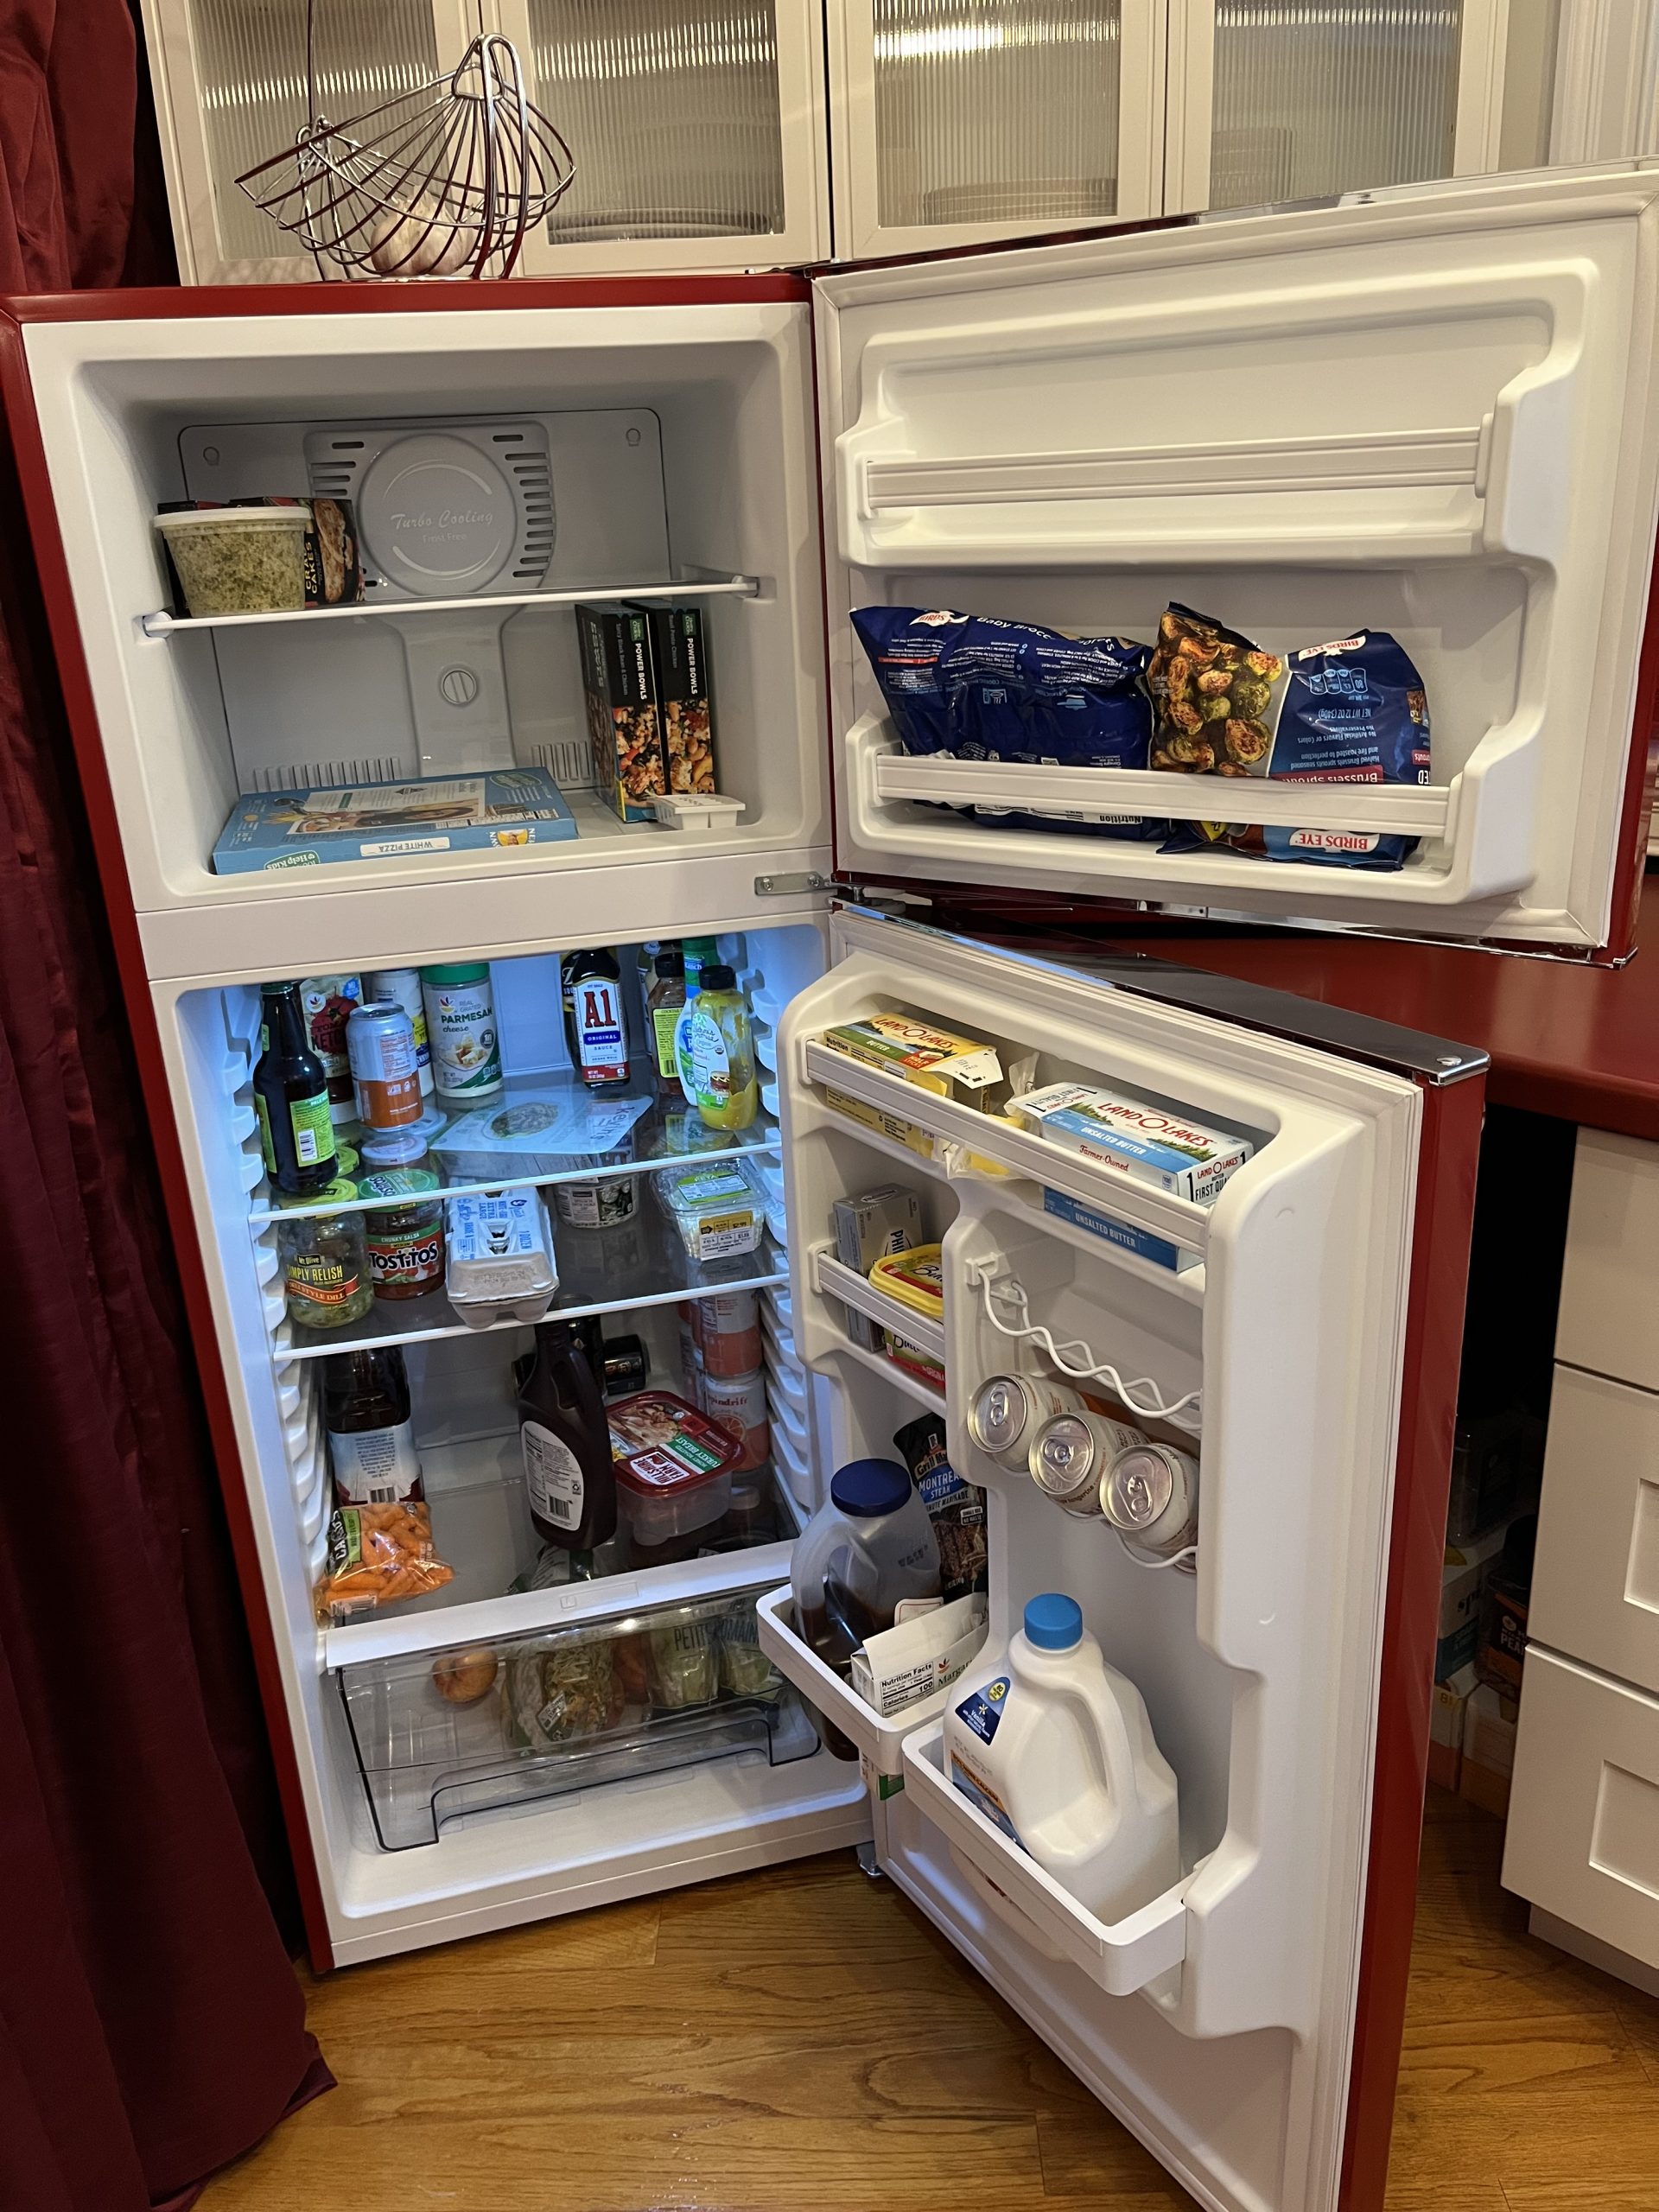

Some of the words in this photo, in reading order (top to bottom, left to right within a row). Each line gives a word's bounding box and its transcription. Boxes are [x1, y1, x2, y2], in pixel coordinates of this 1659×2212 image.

[391, 513, 432, 530] Turbo
[438, 510, 493, 529] Cooling
[306, 542, 318, 594] CAKES
[1014, 625, 1056, 640] Brocc
[1326, 639, 1359, 650] BIRDS
[635, 643, 645, 671] POWER
[687, 638, 696, 666] POWER
[638, 672, 647, 700] BOWLS
[1338, 709, 1345, 719] OZ
[1351, 709, 1361, 718] WT
[1361, 709, 1371, 718] NET
[1323, 734, 1343, 742] Flavors
[1344, 731, 1368, 740] Artificial
[1300, 751, 1328, 761] perfection
[1336, 749, 1357, 759] roasted
[1357, 747, 1367, 756] fire
[1290, 761, 1315, 771] seasoned
[1316, 759, 1336, 768] sprouts
[1338, 757, 1359, 766] Brussels
[1360, 755, 1380, 764] Halved
[1099, 815, 1141, 823] Nutrition
[404, 841, 433, 851] WHITE
[1300, 833, 1322, 845] EYE
[1326, 836, 1369, 850] BIRDS
[378, 843, 403, 853] PIZZA
[266, 859, 287, 869] Kids
[287, 855, 308, 865] Help
[441, 1006, 493, 1024] PARMESAN
[584, 988, 617, 1028] A1
[587, 1033, 617, 1042] ORIGINAL
[874, 1018, 906, 1033] LAND
[923, 1033, 960, 1050] LAKES
[826, 1037, 849, 1051] Nutrition
[866, 1039, 890, 1052] BUTTER
[1098, 1103, 1142, 1121] LAND
[1138, 1117, 1169, 1132] O
[1163, 1125, 1215, 1147] LAKES
[1081, 1126, 1118, 1148] UNSALTED
[1116, 1138, 1147, 1156] BUTTER
[1079, 1145, 1129, 1172] Farmer-Owned
[1197, 1166, 1213, 1179] LAND
[1223, 1156, 1238, 1169] LAKES
[1186, 1172, 1194, 1202] 1
[1195, 1182, 1213, 1201] FIRST
[1075, 1210, 1109, 1235] UNSALTED
[1109, 1225, 1135, 1249] BUTTER
[381, 1235, 403, 1243] CHUNKY
[404, 1232, 420, 1242] SALSA
[519, 1233, 532, 1249] DOZEN
[306, 1255, 321, 1265] Olive
[313, 1265, 343, 1281] RELISH
[302, 1287, 325, 1300] STYLE
[327, 1293, 345, 1301] DILL
[709, 1395, 747, 1406] pindrift
[675, 1436, 699, 1454] BREAST
[696, 1451, 721, 1468] TURKEY
[917, 1457, 936, 1476] Grill
[633, 1458, 671, 1484] HILLSHIRE
[659, 1461, 684, 1479] FARM
[918, 1471, 963, 1492] MONTREA
[931, 1487, 950, 1499] STEAK
[941, 1491, 969, 1507] MARINADE
[881, 1671, 912, 1688] Nutrition
[913, 1663, 932, 1675] Facts
[918, 1681, 933, 1693] 100
[883, 1694, 909, 1707] Calories
